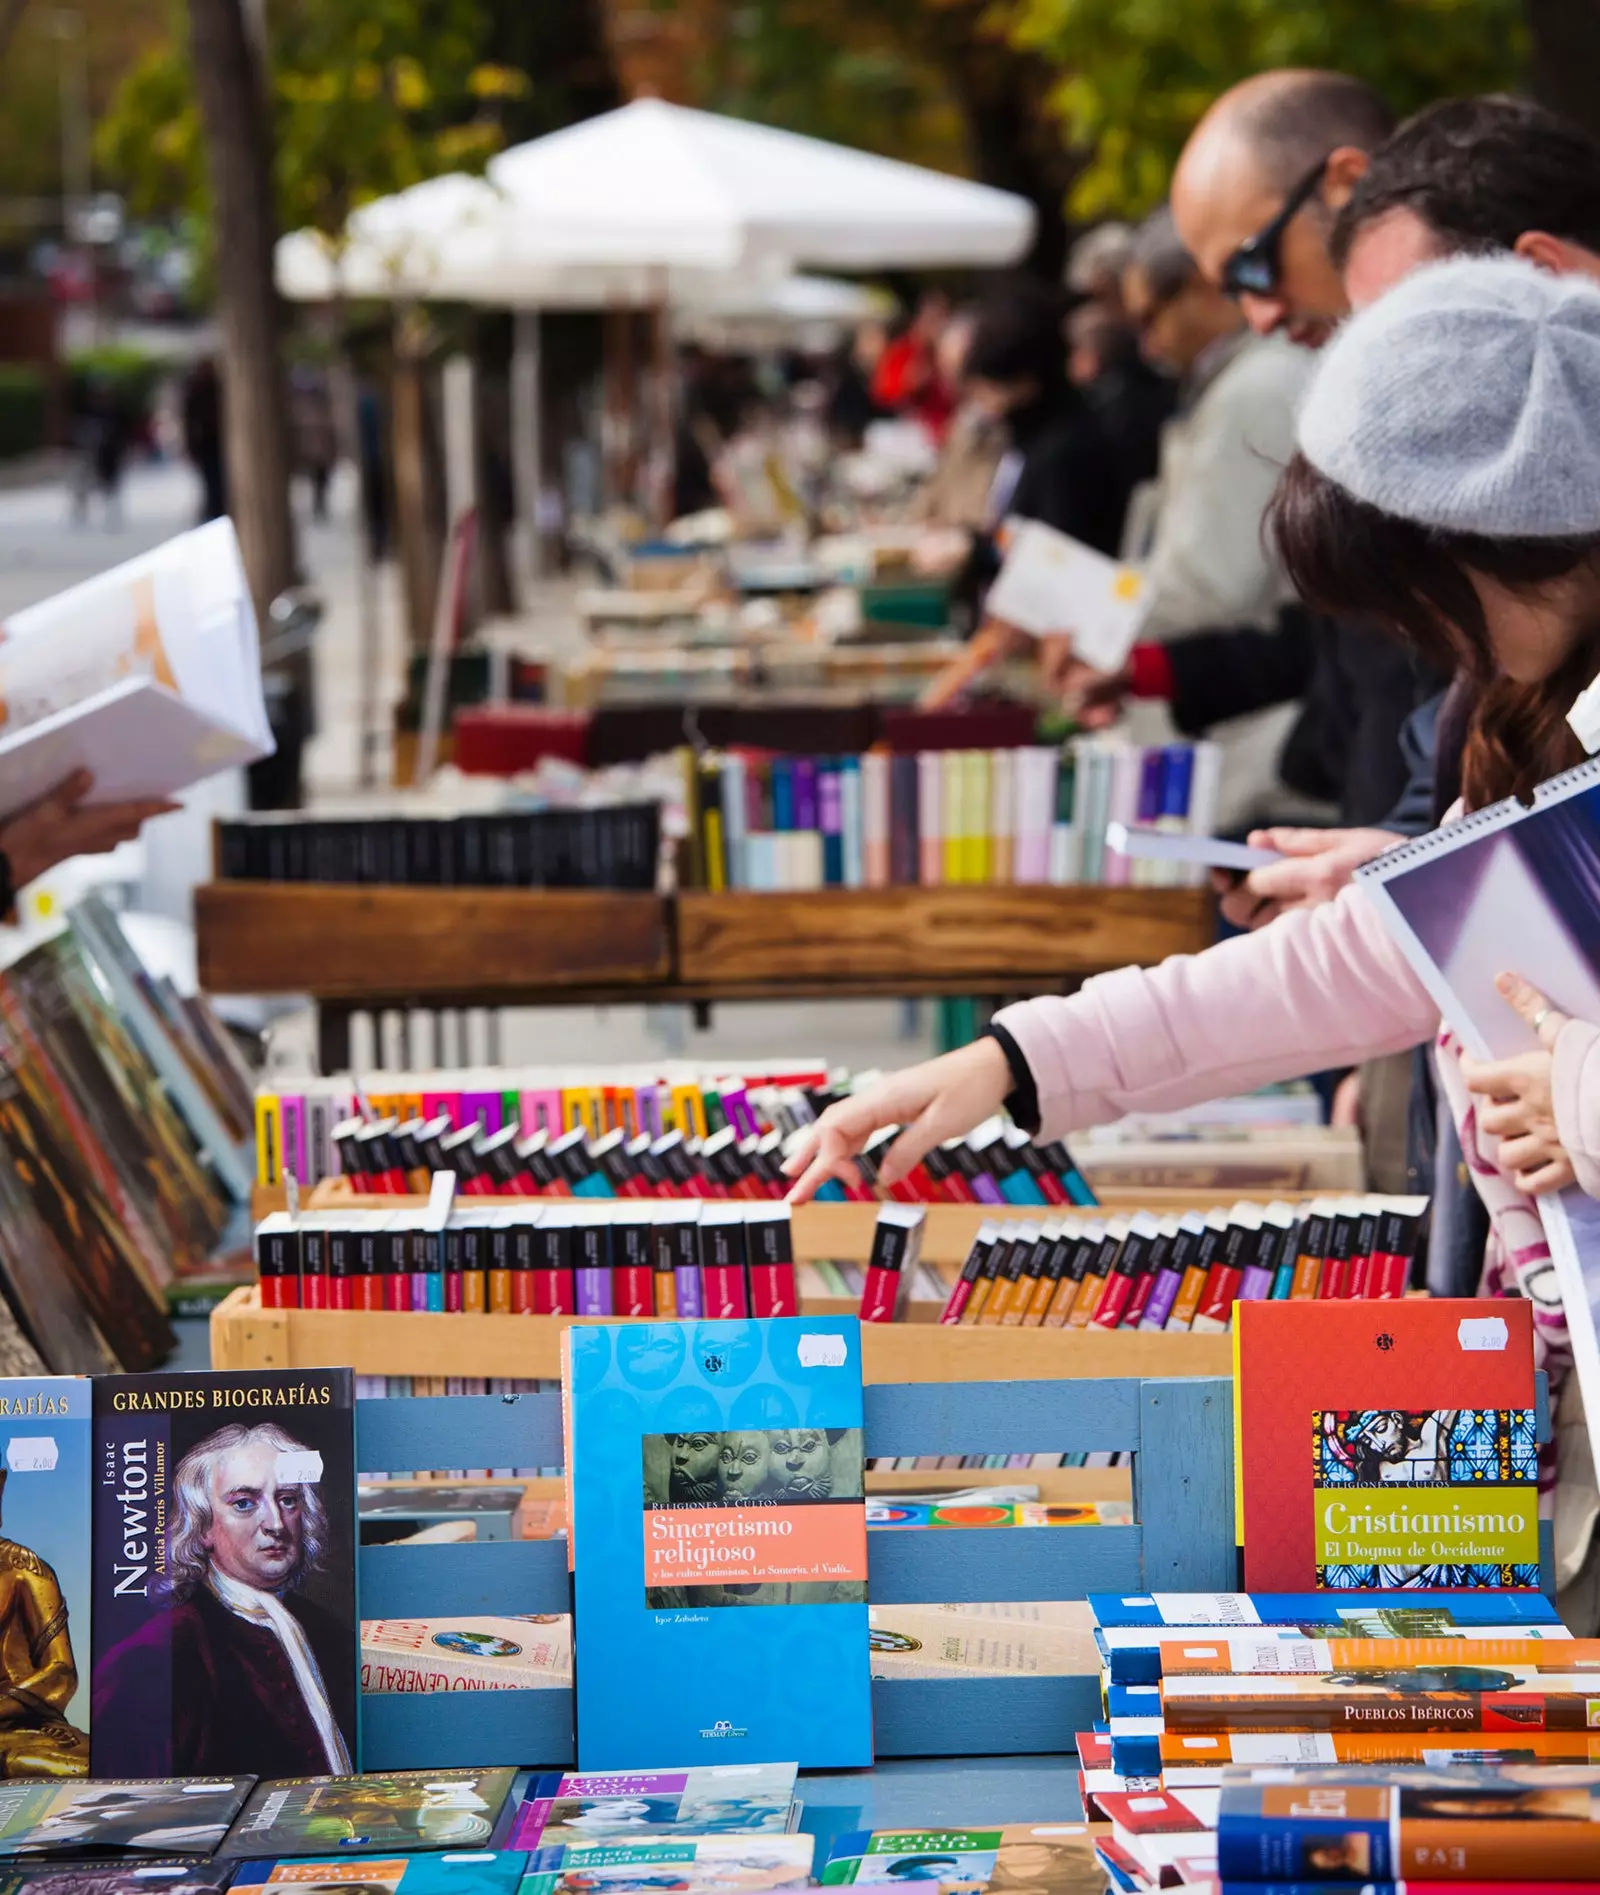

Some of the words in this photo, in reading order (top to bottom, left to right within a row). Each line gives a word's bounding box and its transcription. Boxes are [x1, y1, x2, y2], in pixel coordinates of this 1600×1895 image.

[112, 1389, 206, 1411] GRANDES
[211, 1382, 332, 1408] BIOGRAFÍAS
[103, 1441, 116, 1485] Isaac
[154, 1441, 166, 1498] Villamor
[113, 1438, 148, 1599] Newton
[154, 1499, 166, 1537] Perris
[651, 1514, 793, 1540] Sincretismo
[1324, 1502, 1525, 1534] Cristianismo
[154, 1539, 166, 1576] Alicia
[652, 1538, 756, 1570] religioso
[1324, 1540, 1340, 1557] El
[1346, 1540, 1402, 1561] Dogma
[1407, 1540, 1426, 1557] de
[1431, 1540, 1505, 1557] Occidente
[660, 1568, 674, 1579] los
[676, 1568, 703, 1579] cultos
[655, 1614, 672, 1626] Igor
[377, 1665, 449, 1692] GENERAL
[1344, 1705, 1406, 1720] PUEBLOS
[1410, 1702, 1475, 1720] IBÉRICOS
[569, 1774, 658, 1786] Louisa
[875, 1841, 978, 1852] Kahlo
[878, 1833, 968, 1845] Frida
